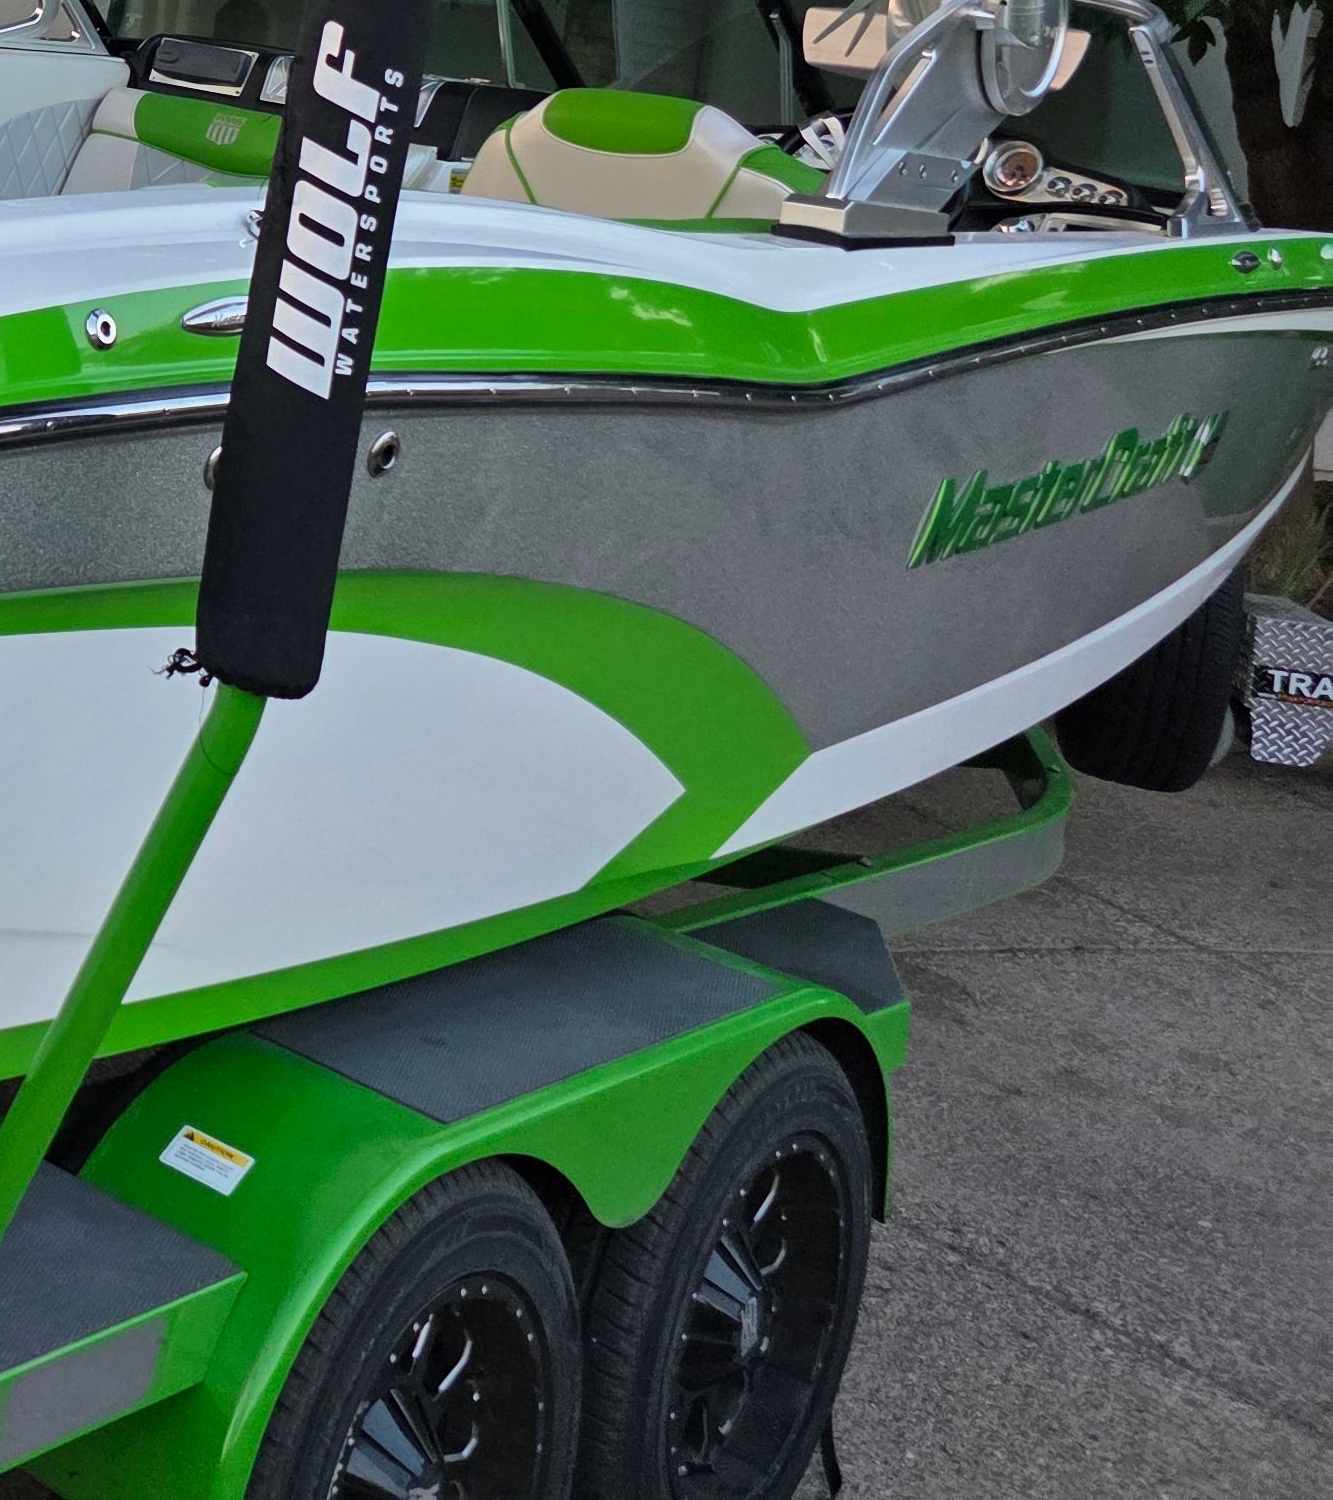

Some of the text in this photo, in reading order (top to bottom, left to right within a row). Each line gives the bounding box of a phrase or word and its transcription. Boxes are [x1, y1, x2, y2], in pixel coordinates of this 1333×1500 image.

[266, 20, 381, 400] WOLF
[335, 67, 405, 376] WATERSPORTS
[1267, 668, 1333, 700] TRA
